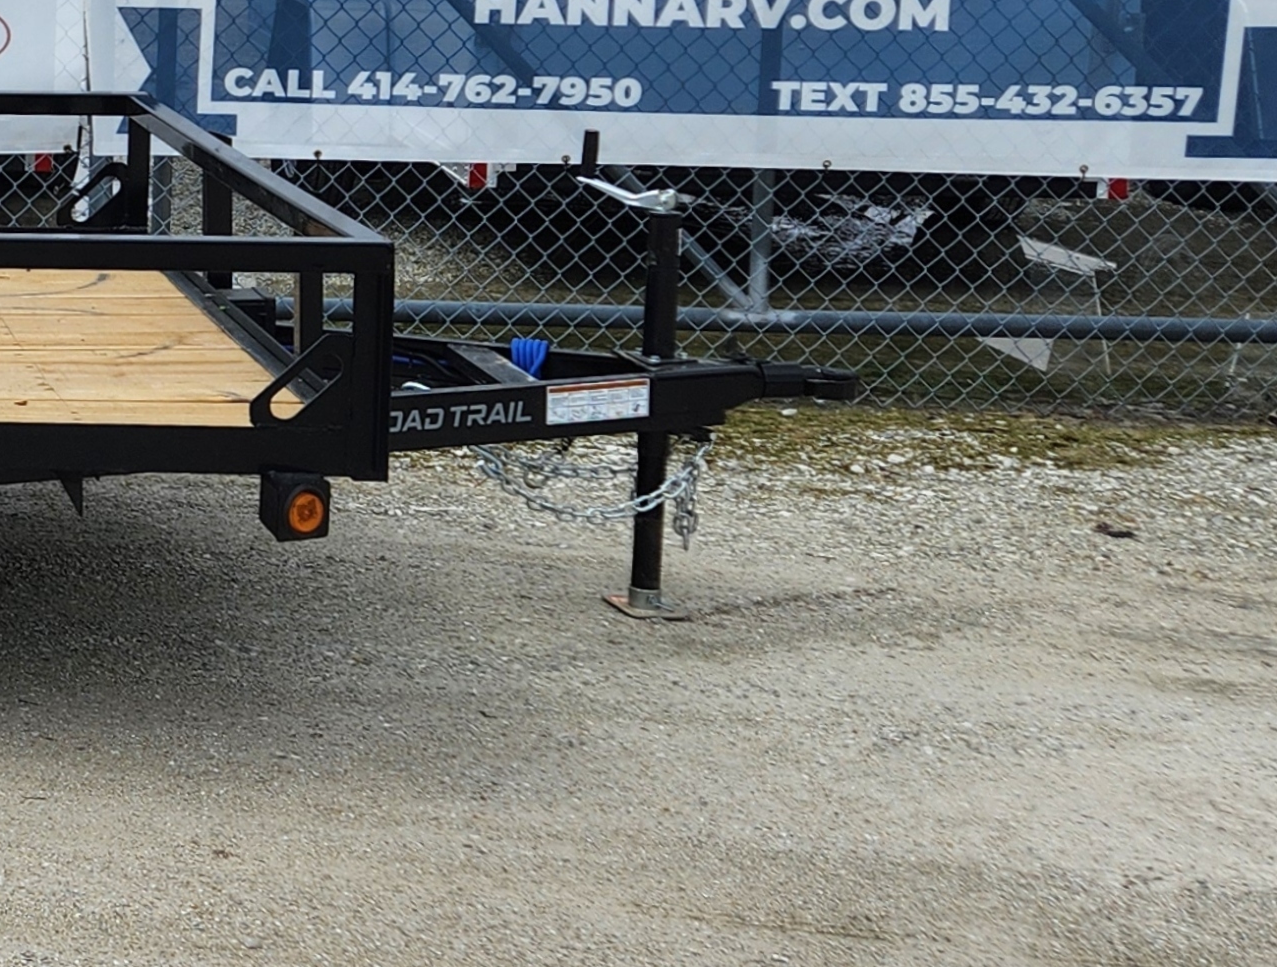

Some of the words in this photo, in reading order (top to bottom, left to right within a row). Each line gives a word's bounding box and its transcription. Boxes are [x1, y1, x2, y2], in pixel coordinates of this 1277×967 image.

[224, 67, 335, 98] CALL
[347, 71, 643, 107] 414-762-7950
[771, 80, 890, 112] TEXT
[898, 82, 1205, 117] 855-432-6357
[389, 407, 445, 433] OAD
[449, 400, 532, 427] TRAIL
